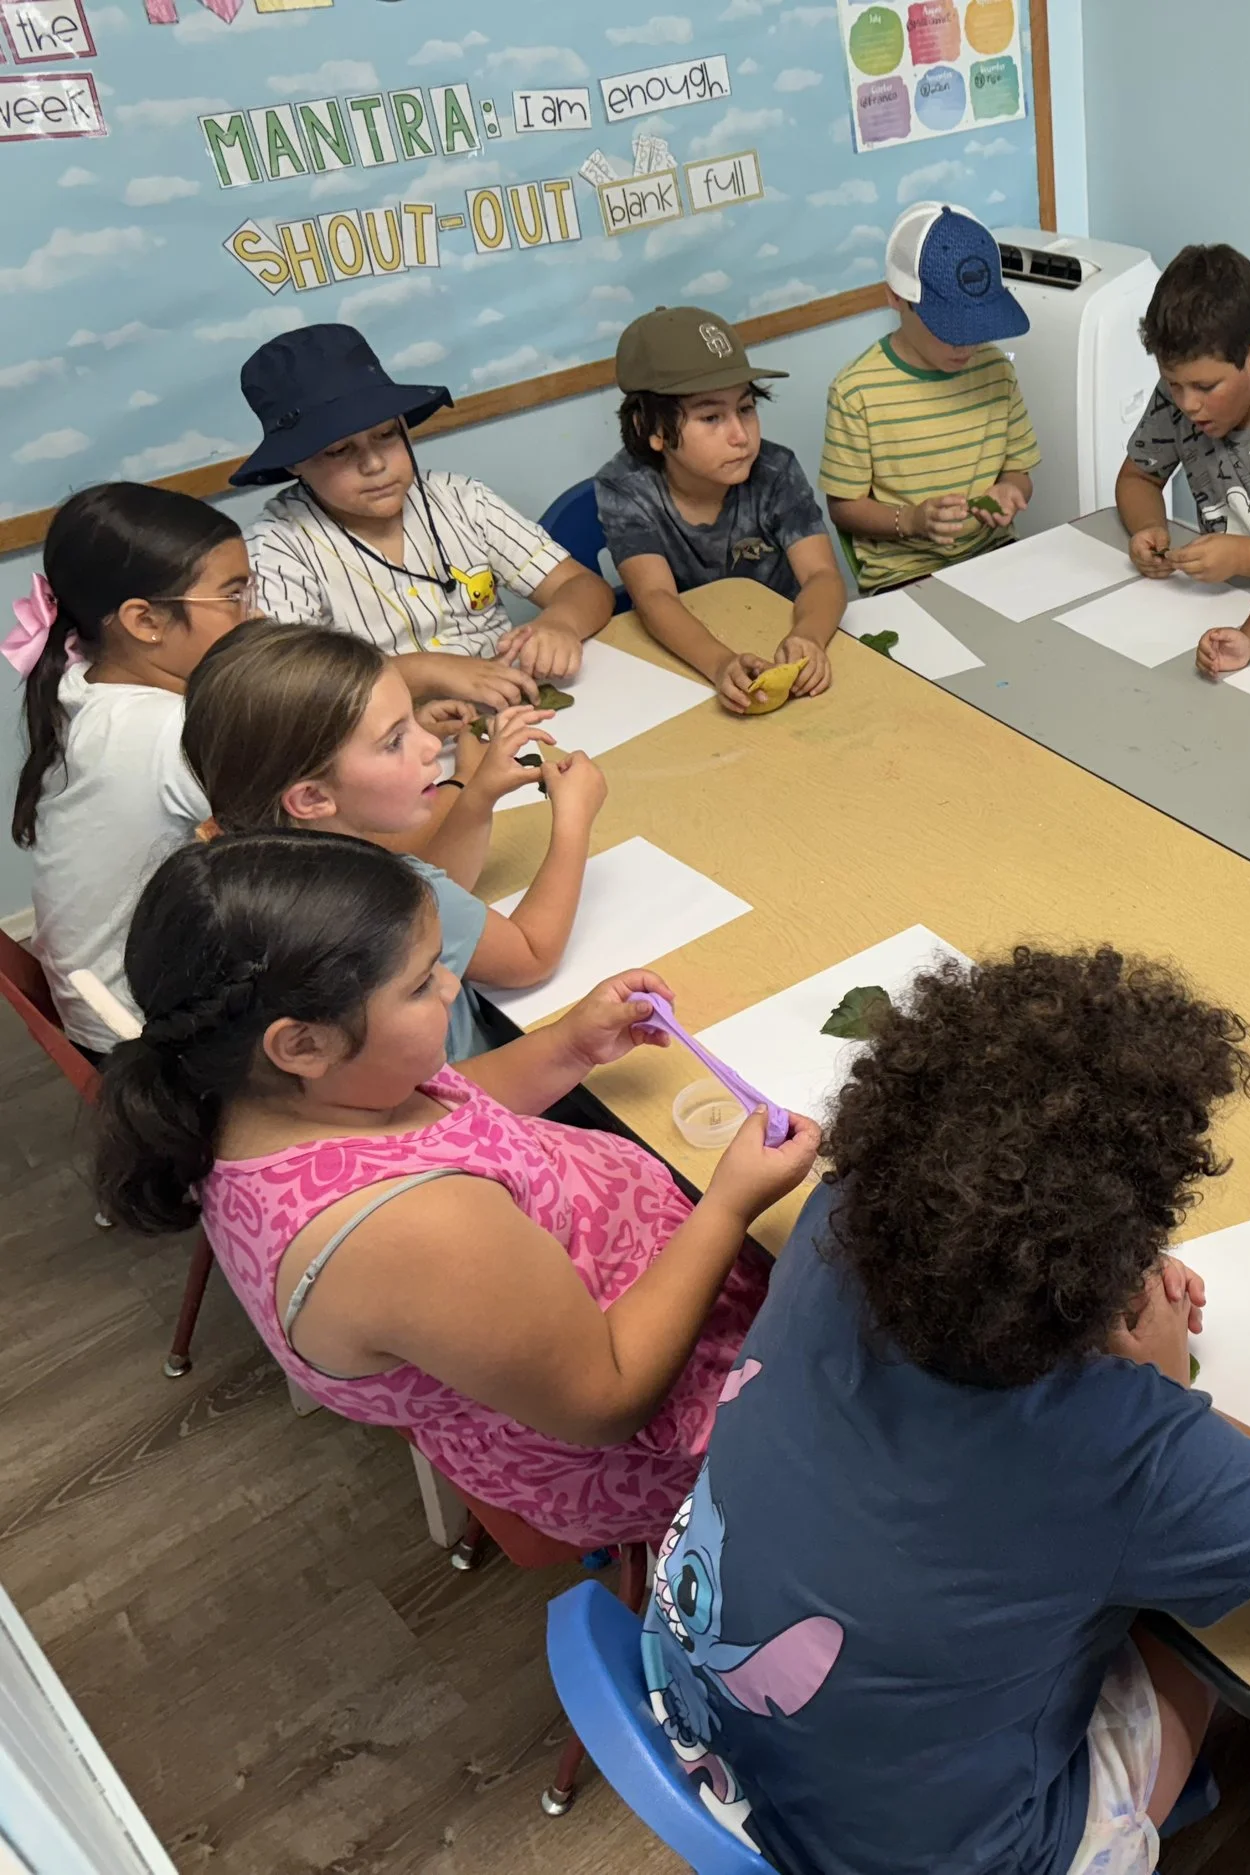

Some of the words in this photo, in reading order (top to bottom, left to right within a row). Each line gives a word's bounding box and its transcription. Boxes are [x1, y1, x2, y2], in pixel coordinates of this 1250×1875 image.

[16, 8, 78, 52] the
[204, 88, 497, 187] MANTRA:
[520, 95, 534, 128] I
[541, 97, 587, 127] am
[607, 61, 729, 114] enough.
[232, 181, 571, 290] SHOUT-OUT
[606, 182, 673, 226] blank
[703, 160, 746, 203] full
